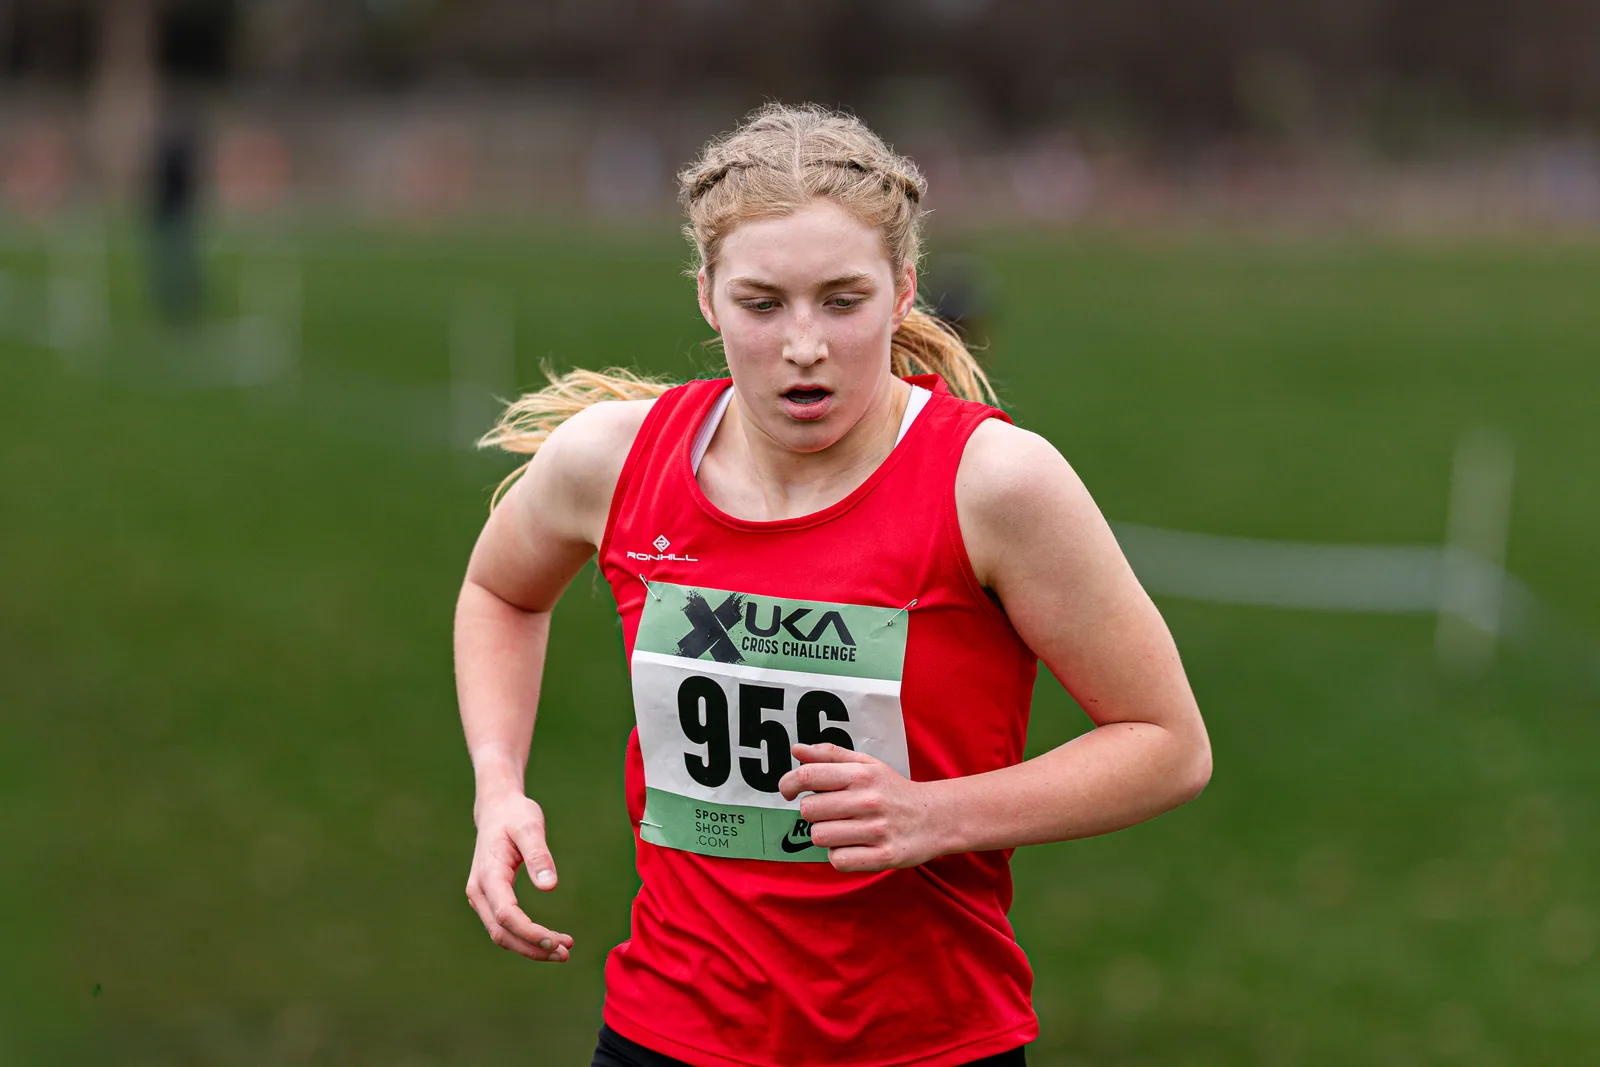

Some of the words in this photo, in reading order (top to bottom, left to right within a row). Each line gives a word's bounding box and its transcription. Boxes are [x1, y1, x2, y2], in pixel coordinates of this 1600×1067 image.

[627, 551, 698, 562] RONHILL
[745, 602, 856, 646] UKA
[741, 636, 779, 655] CROSS
[782, 642, 857, 663] CHALLENGE
[695, 808, 745, 825] SPORTS
[695, 821, 738, 837] SHOES
[695, 834, 729, 848] .COM
